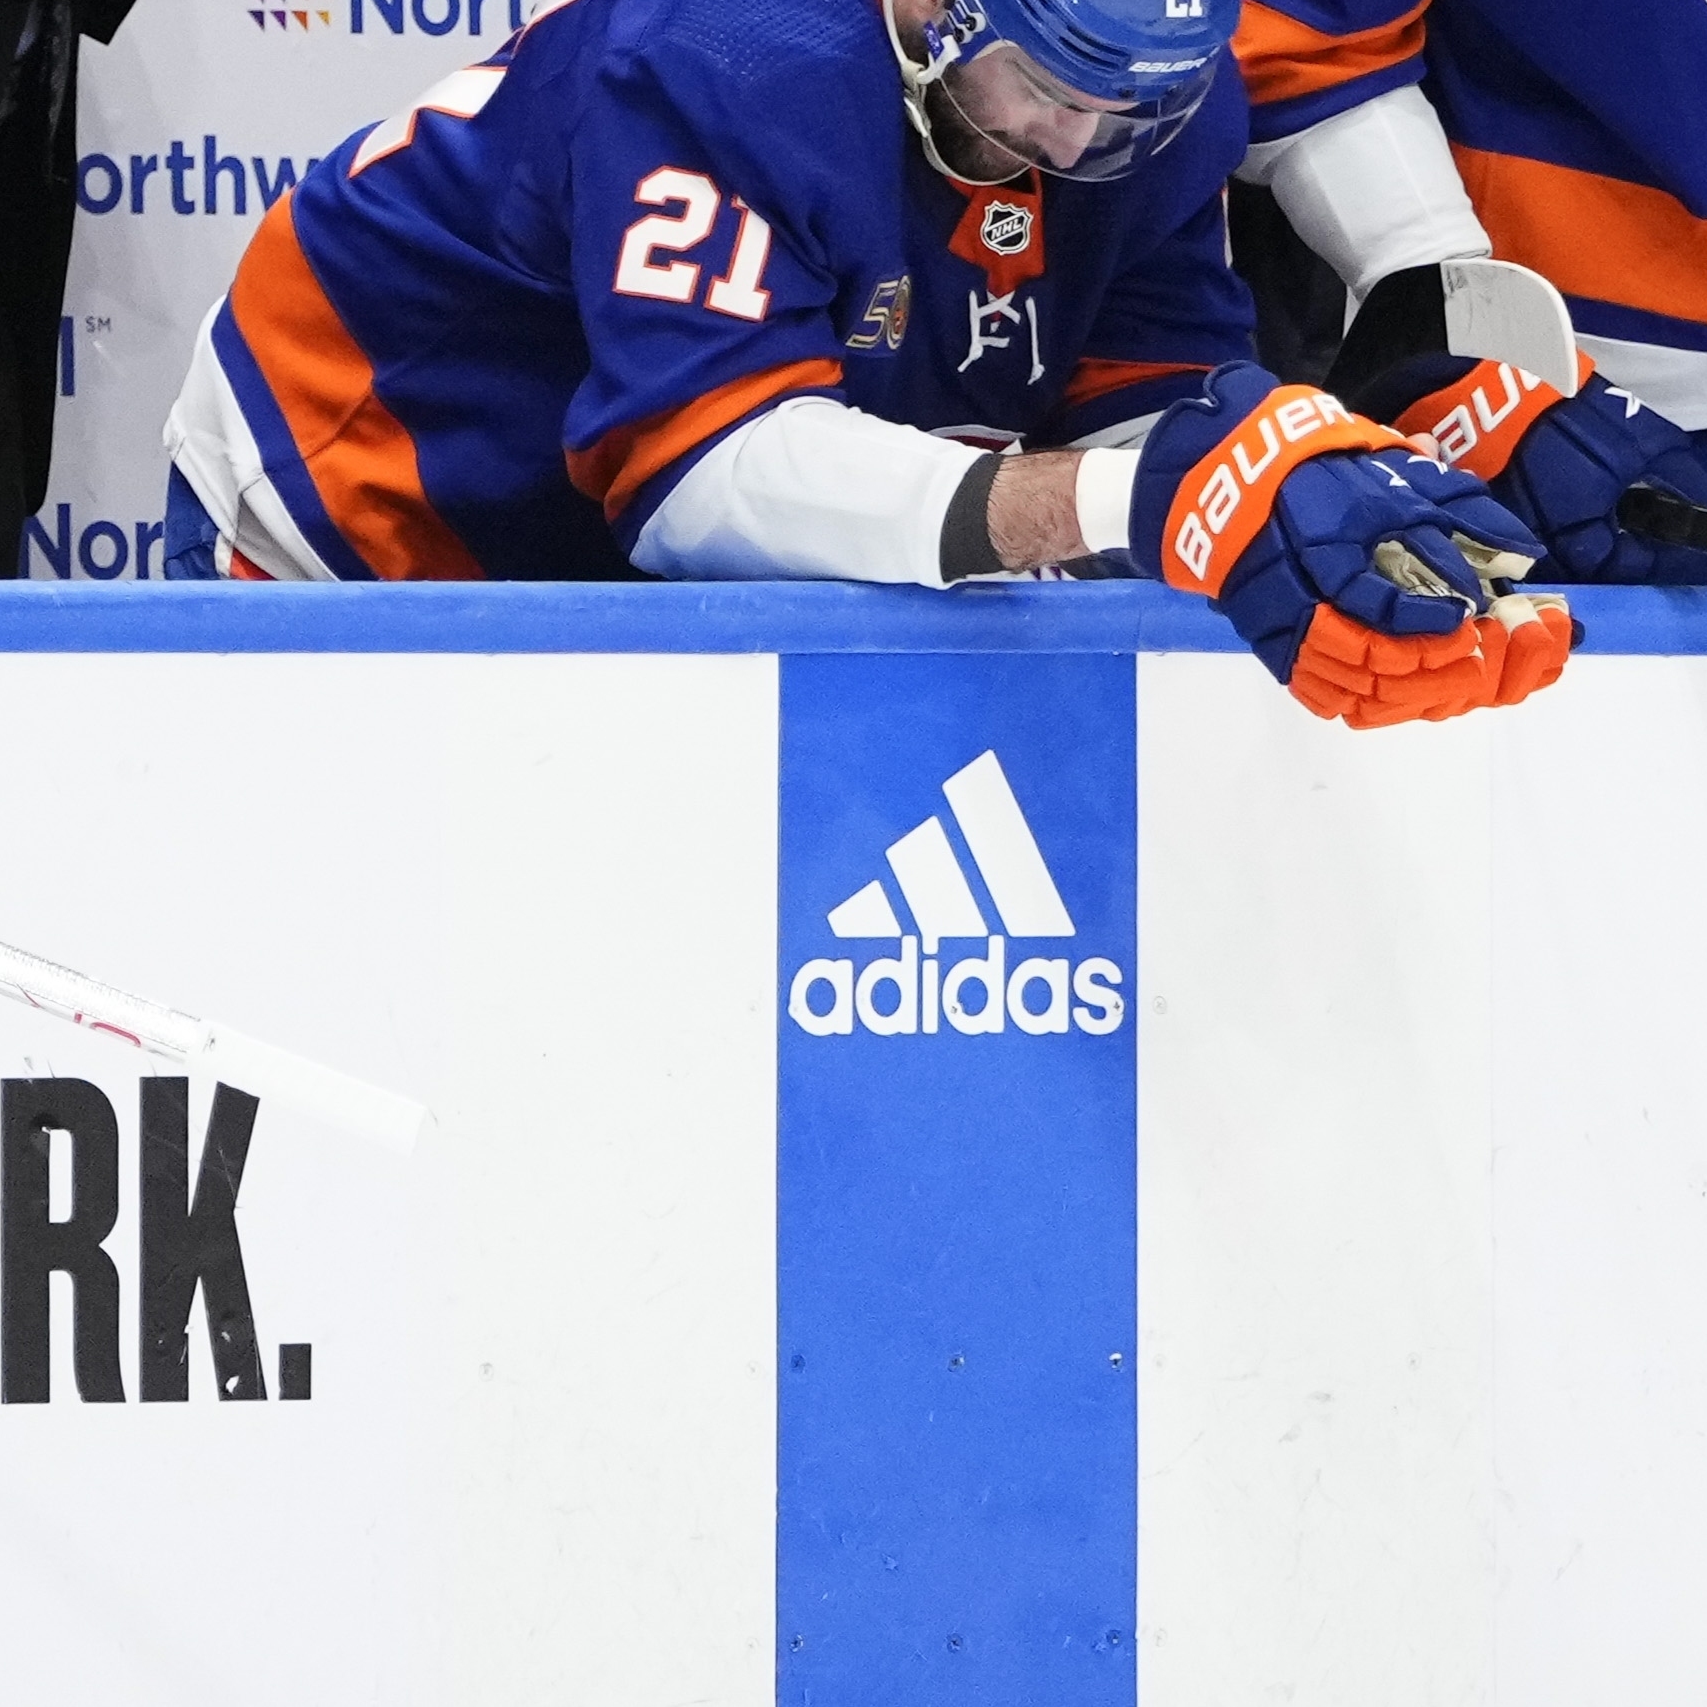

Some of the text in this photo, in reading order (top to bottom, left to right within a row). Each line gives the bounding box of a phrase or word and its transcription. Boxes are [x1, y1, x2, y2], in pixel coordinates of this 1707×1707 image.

[1128, 57, 1209, 74] BAUER
[613, 165, 772, 323] 21
[990, 216, 1024, 242] NHL
[1174, 392, 1356, 583] BAUER
[788, 934, 1125, 1037] adidas
